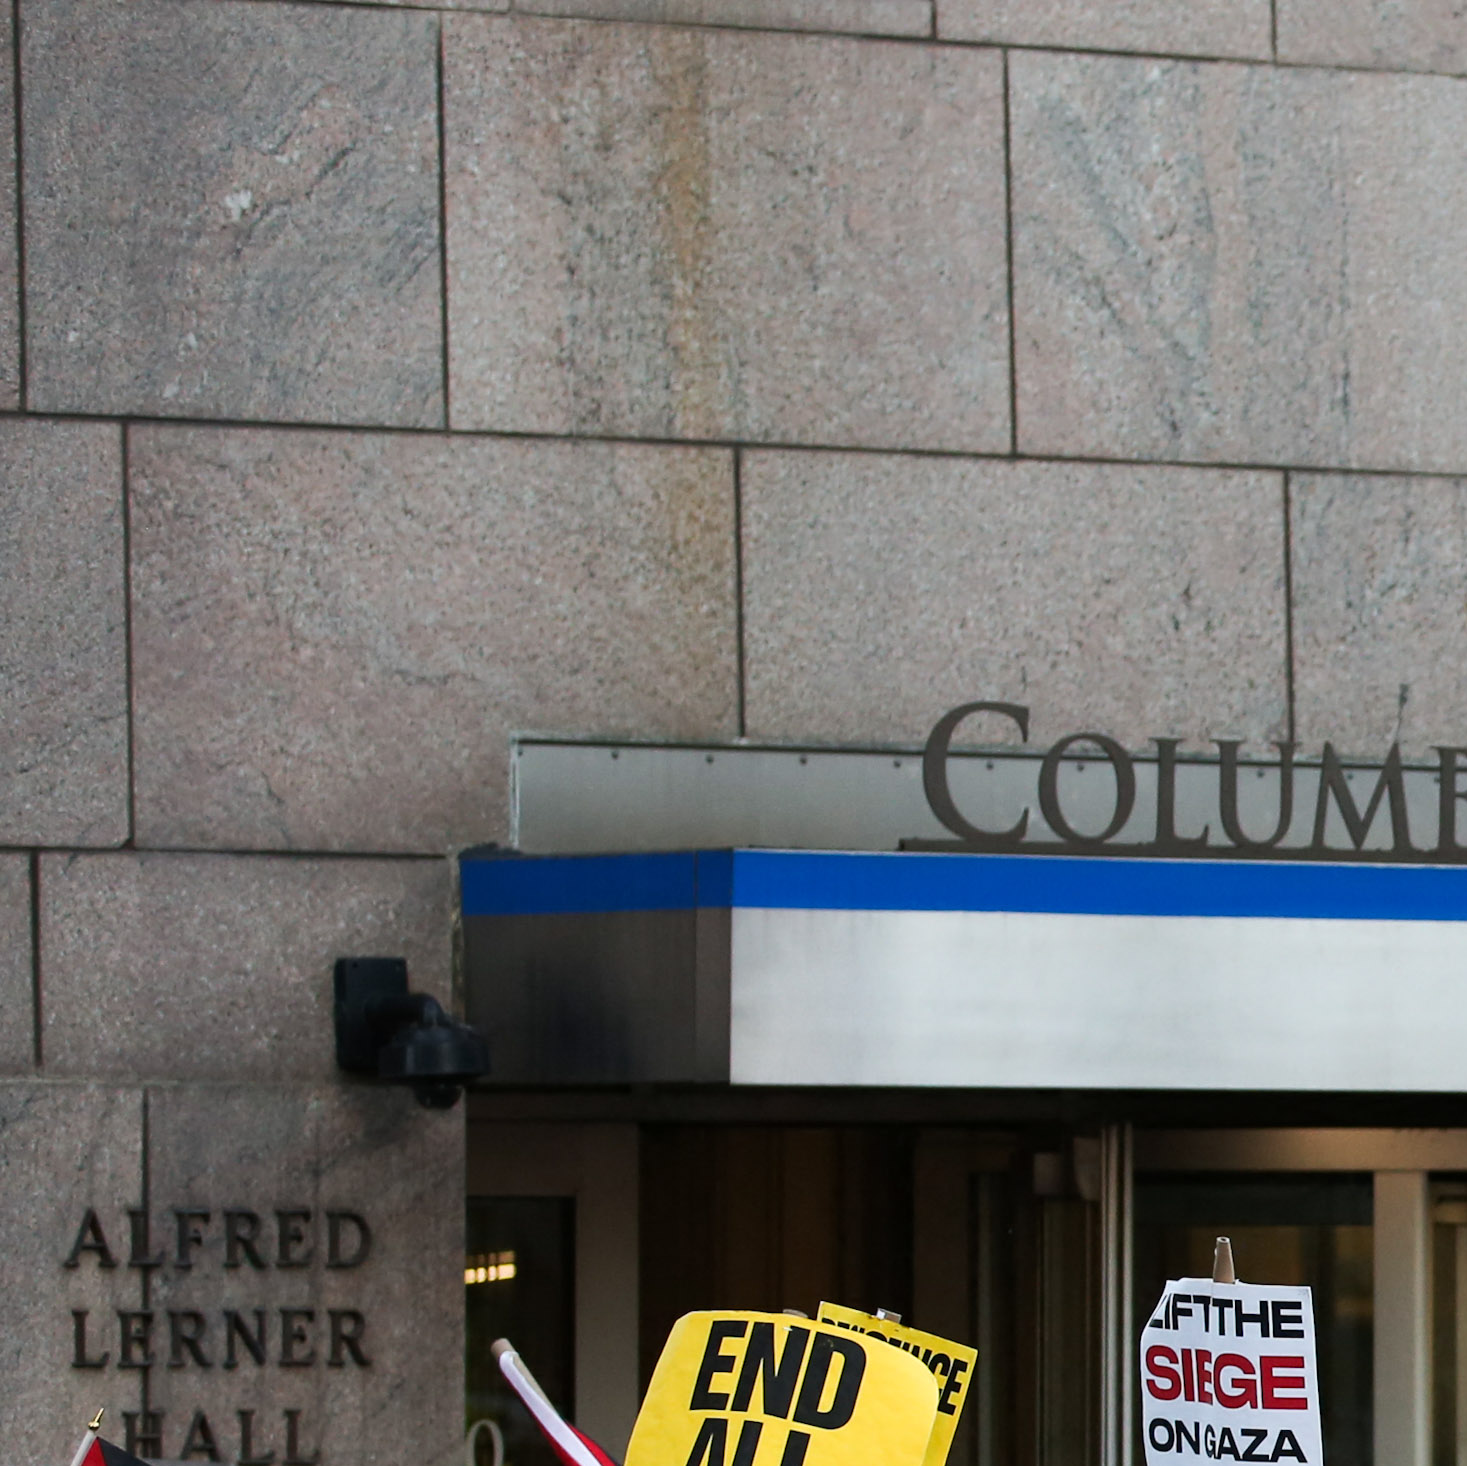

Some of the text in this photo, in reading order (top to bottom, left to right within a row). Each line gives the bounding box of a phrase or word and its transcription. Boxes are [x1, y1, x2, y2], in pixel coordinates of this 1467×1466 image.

[64, 1208, 374, 1270] ALFRED
[71, 1309, 372, 1370] LERNER
[1212, 1300, 1305, 1339] THE
[689, 1319, 868, 1431] END
[1145, 1344, 1309, 1411] SIEGE
[1149, 1417, 1309, 1464] ON GAZA
